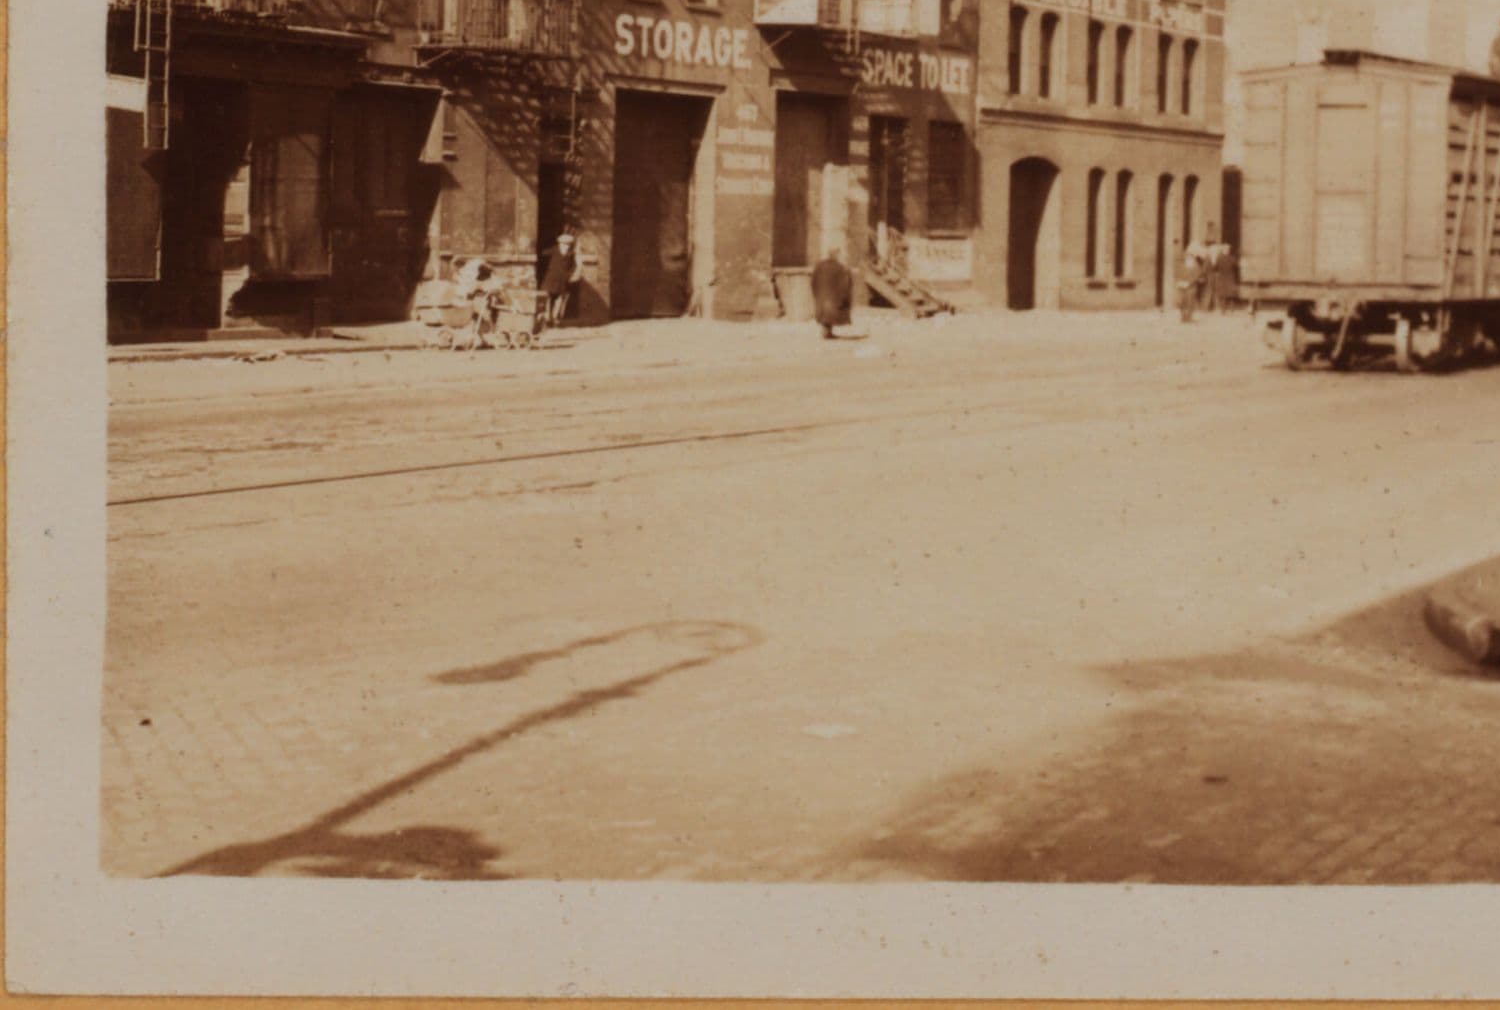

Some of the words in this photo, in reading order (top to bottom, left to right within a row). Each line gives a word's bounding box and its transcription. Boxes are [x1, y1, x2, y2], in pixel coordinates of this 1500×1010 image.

[861, 48, 914, 88] SPACE
[918, 52, 939, 90] TO
[940, 56, 971, 94] LET
